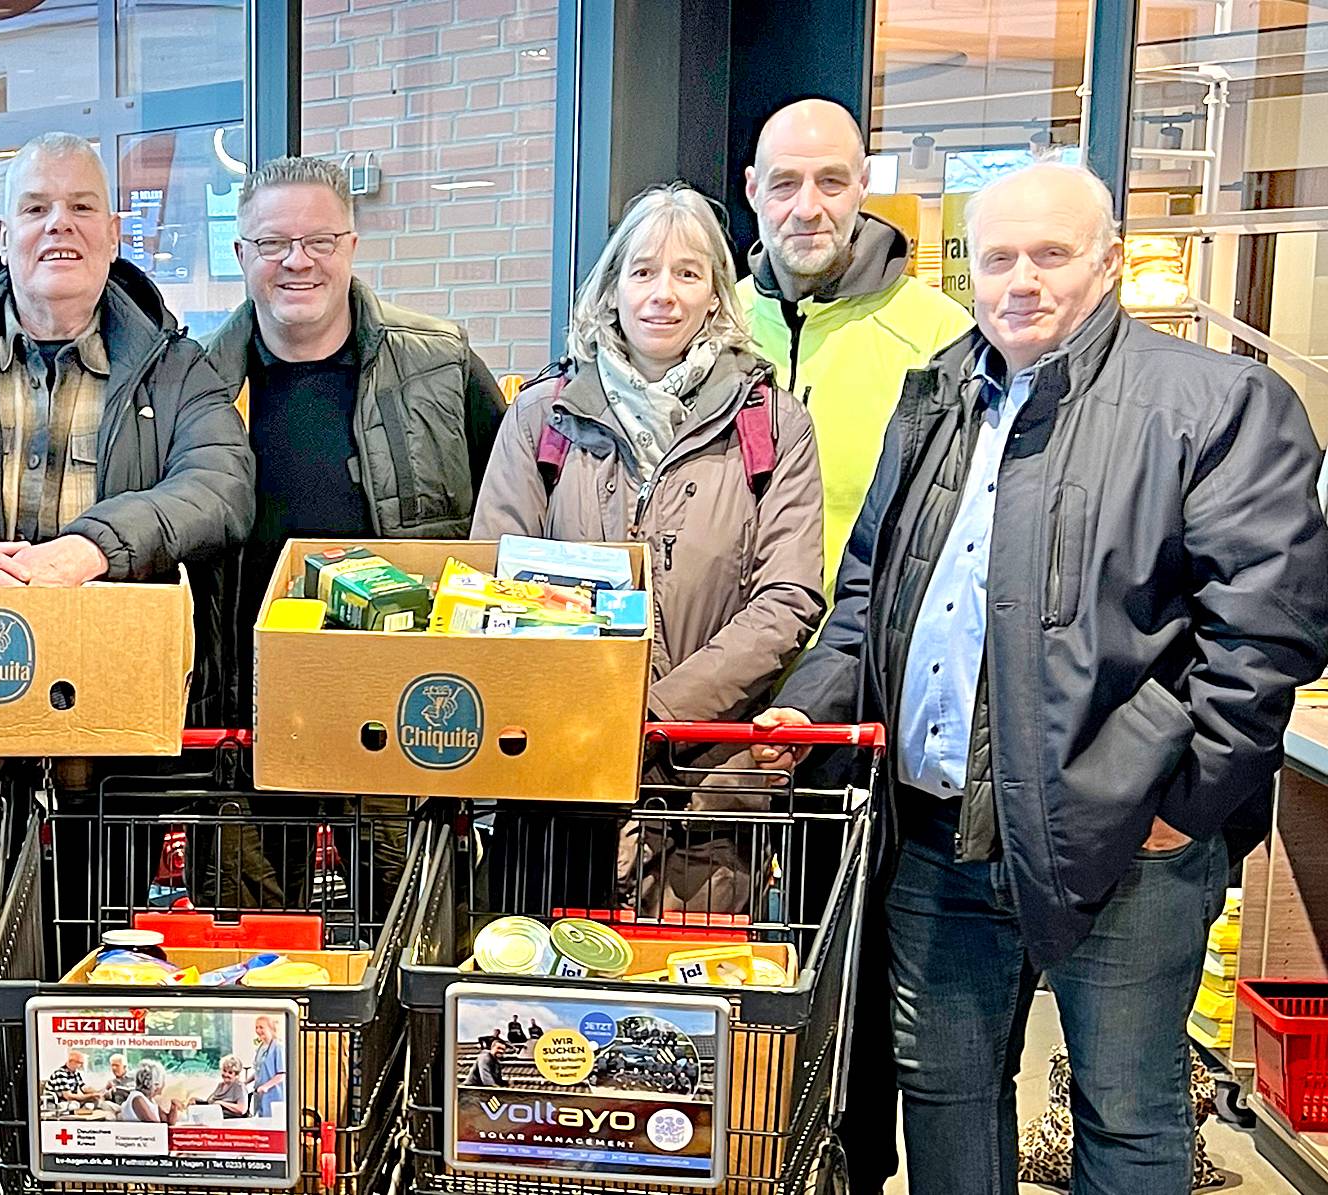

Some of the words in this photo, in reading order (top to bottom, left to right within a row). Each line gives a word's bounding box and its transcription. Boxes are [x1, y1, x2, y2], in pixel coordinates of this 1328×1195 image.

[401, 725, 478, 753] Chiquita
[679, 963, 703, 984] ja!
[57, 1019, 101, 1031] JETZT
[105, 1019, 140, 1032] NEU!
[585, 1022, 613, 1031] JETZT
[56, 1037, 114, 1048] Tagespflege
[117, 1038, 126, 1046] in
[129, 1038, 198, 1049] Hohenlimburg
[542, 1047, 585, 1055] SUCHEN
[479, 1131, 525, 1141] SOLAR
[533, 1135, 634, 1148] MANAGEMENT
[56, 1157, 112, 1166] kv-hagen.drk.de
[181, 1160, 204, 1168] Hagen
[225, 1161, 246, 1169] 02331
